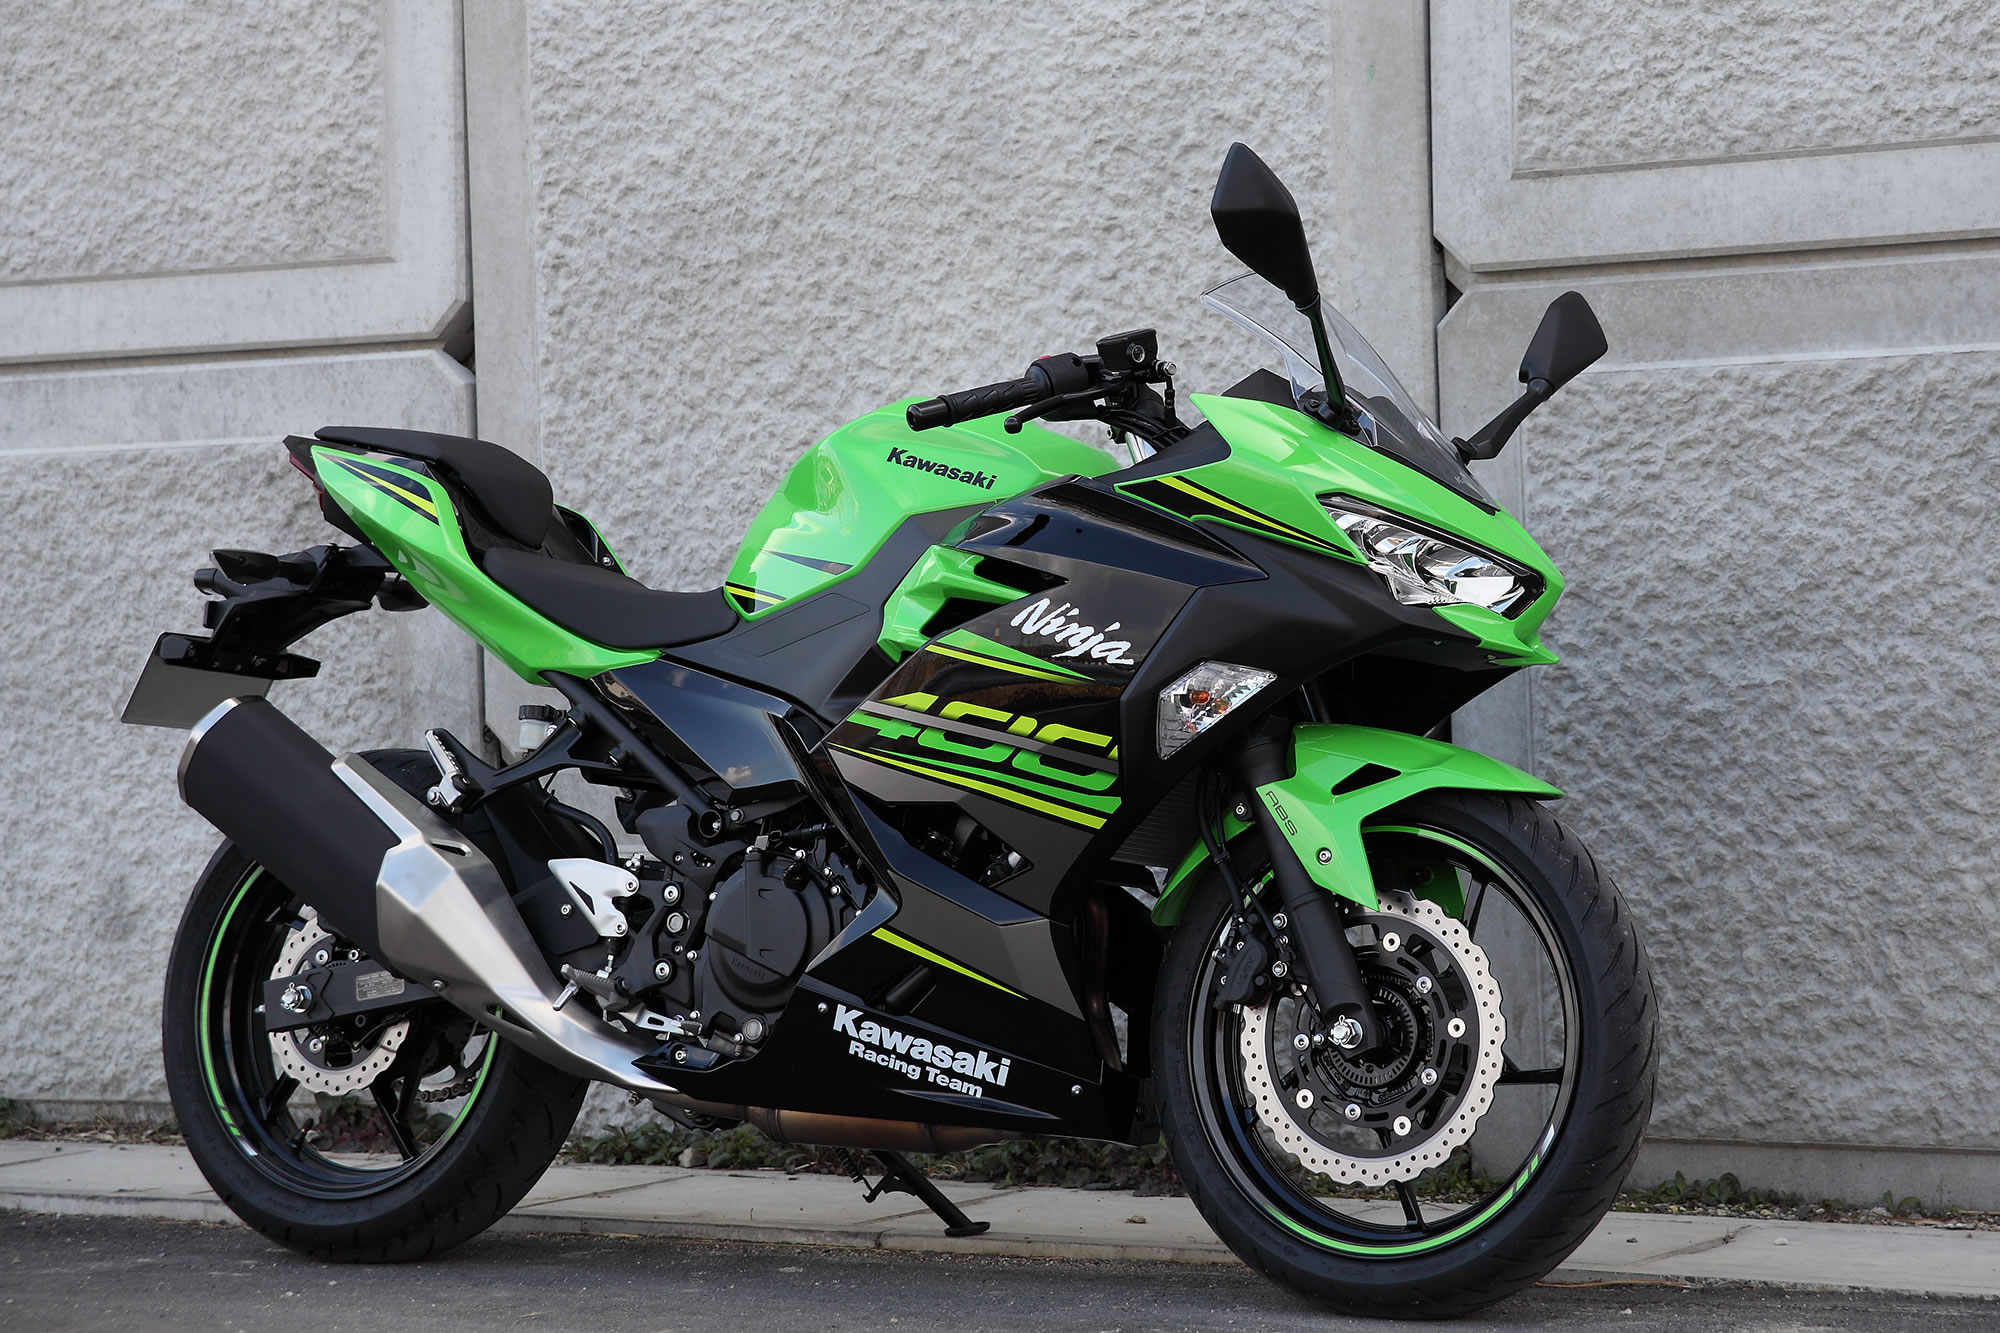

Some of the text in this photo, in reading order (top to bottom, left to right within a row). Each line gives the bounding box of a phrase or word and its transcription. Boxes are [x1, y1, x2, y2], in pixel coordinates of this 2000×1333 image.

[886, 447, 997, 490] Kawasaki
[1010, 598, 1135, 665] Ninja
[1265, 790, 1298, 836] ABS
[832, 1004, 1011, 1087] Kawasaki
[848, 1040, 983, 1098] Racing Team
